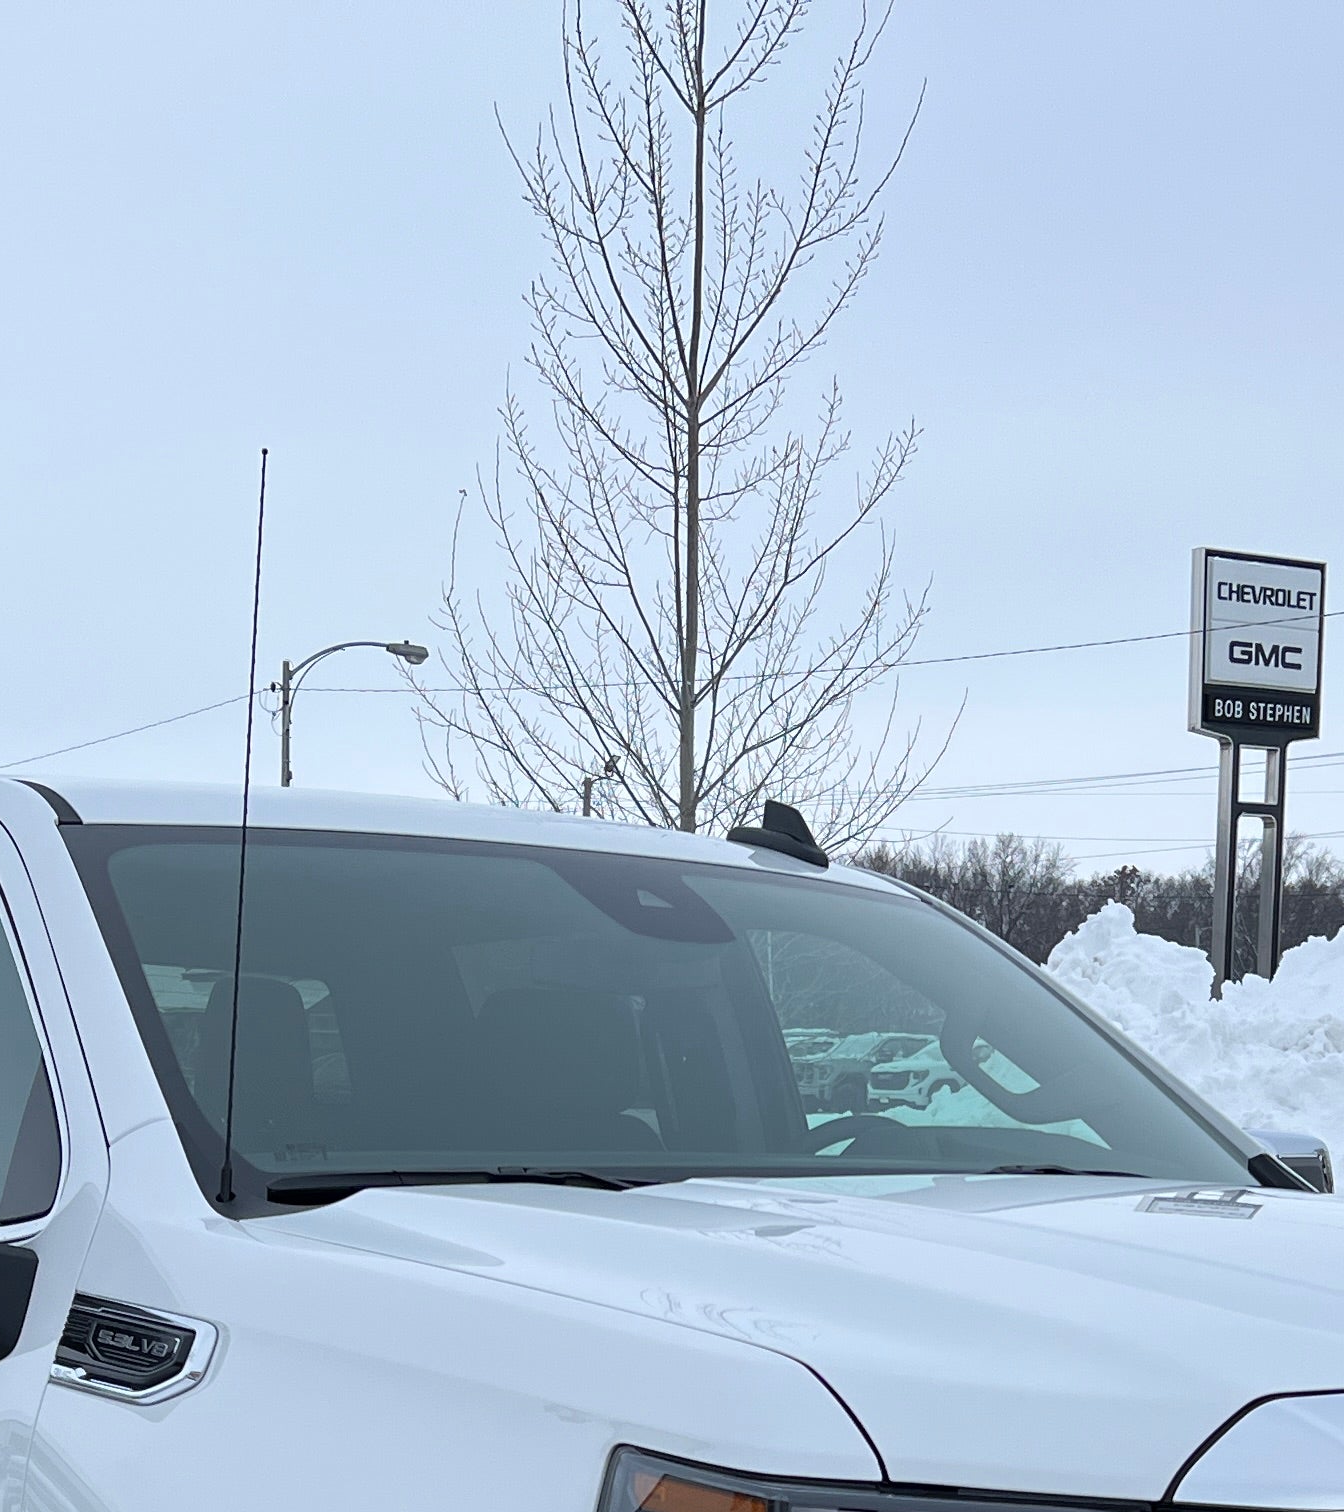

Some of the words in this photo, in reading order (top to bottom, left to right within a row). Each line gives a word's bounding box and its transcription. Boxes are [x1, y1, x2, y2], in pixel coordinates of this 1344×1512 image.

[1217, 581, 1317, 611] CHEVROLET
[1228, 640, 1303, 671] GMC
[1214, 698, 1243, 719] BOB
[1249, 702, 1311, 725] STEPHEN
